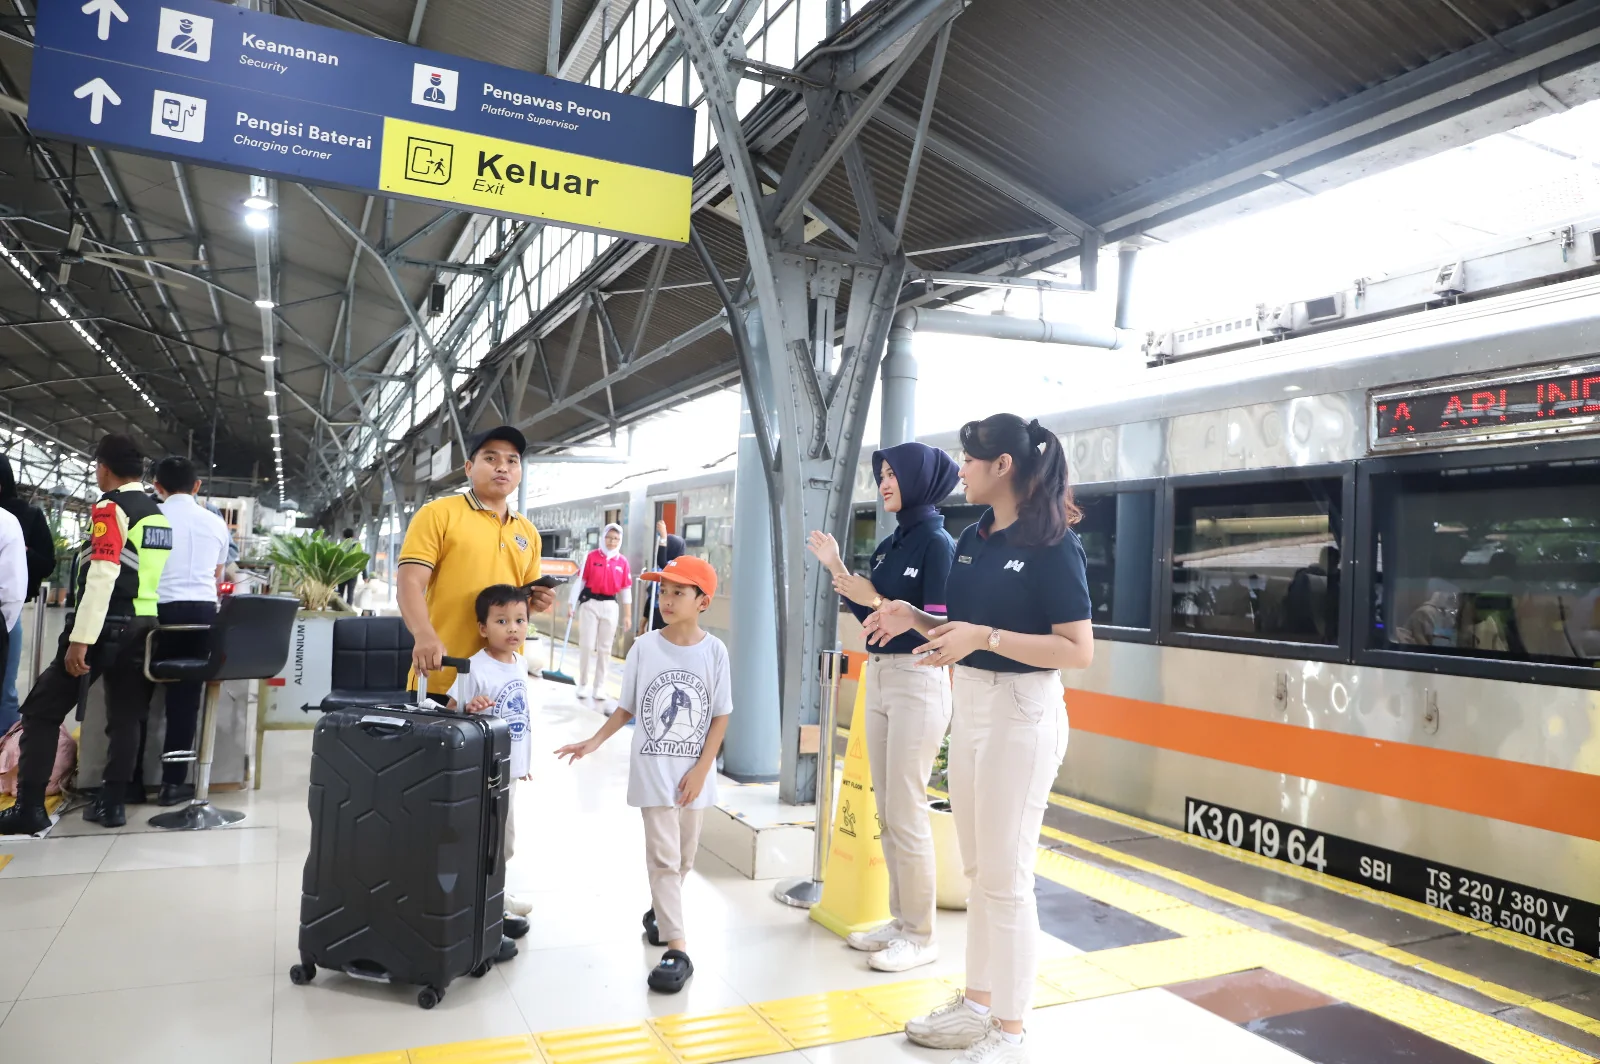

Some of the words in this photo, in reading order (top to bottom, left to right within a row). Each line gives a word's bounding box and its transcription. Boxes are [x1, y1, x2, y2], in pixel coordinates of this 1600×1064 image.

[239, 54, 288, 75] Security
[242, 32, 339, 66] Keamanan
[480, 103, 525, 120] Platform
[526, 112, 579, 131] Supervisor
[483, 83, 563, 111] Pengawas
[567, 101, 611, 121] Peron
[233, 134, 289, 155] Charging
[292, 144, 332, 160] Corner
[236, 111, 303, 137] Pengisi
[308, 125, 372, 150] Baterai
[472, 178, 505, 196] Exit
[477, 150, 600, 197] Keluar
[1378, 402, 1416, 433] A
[1441, 389, 1507, 428] API
[294, 624, 305, 686] ALUMINIUM
[644, 681, 660, 714] SURFING
[660, 672, 696, 684] BEACHES
[695, 681, 704, 692] ON
[851, 782, 863, 790] FLOOR
[1359, 856, 1391, 884] SBI
[1425, 888, 1453, 912] BK
[1426, 867, 1451, 890] TS
[1458, 877, 1493, 902] 220
[1510, 891, 1548, 917] 380
[1552, 902, 1569, 922] V
